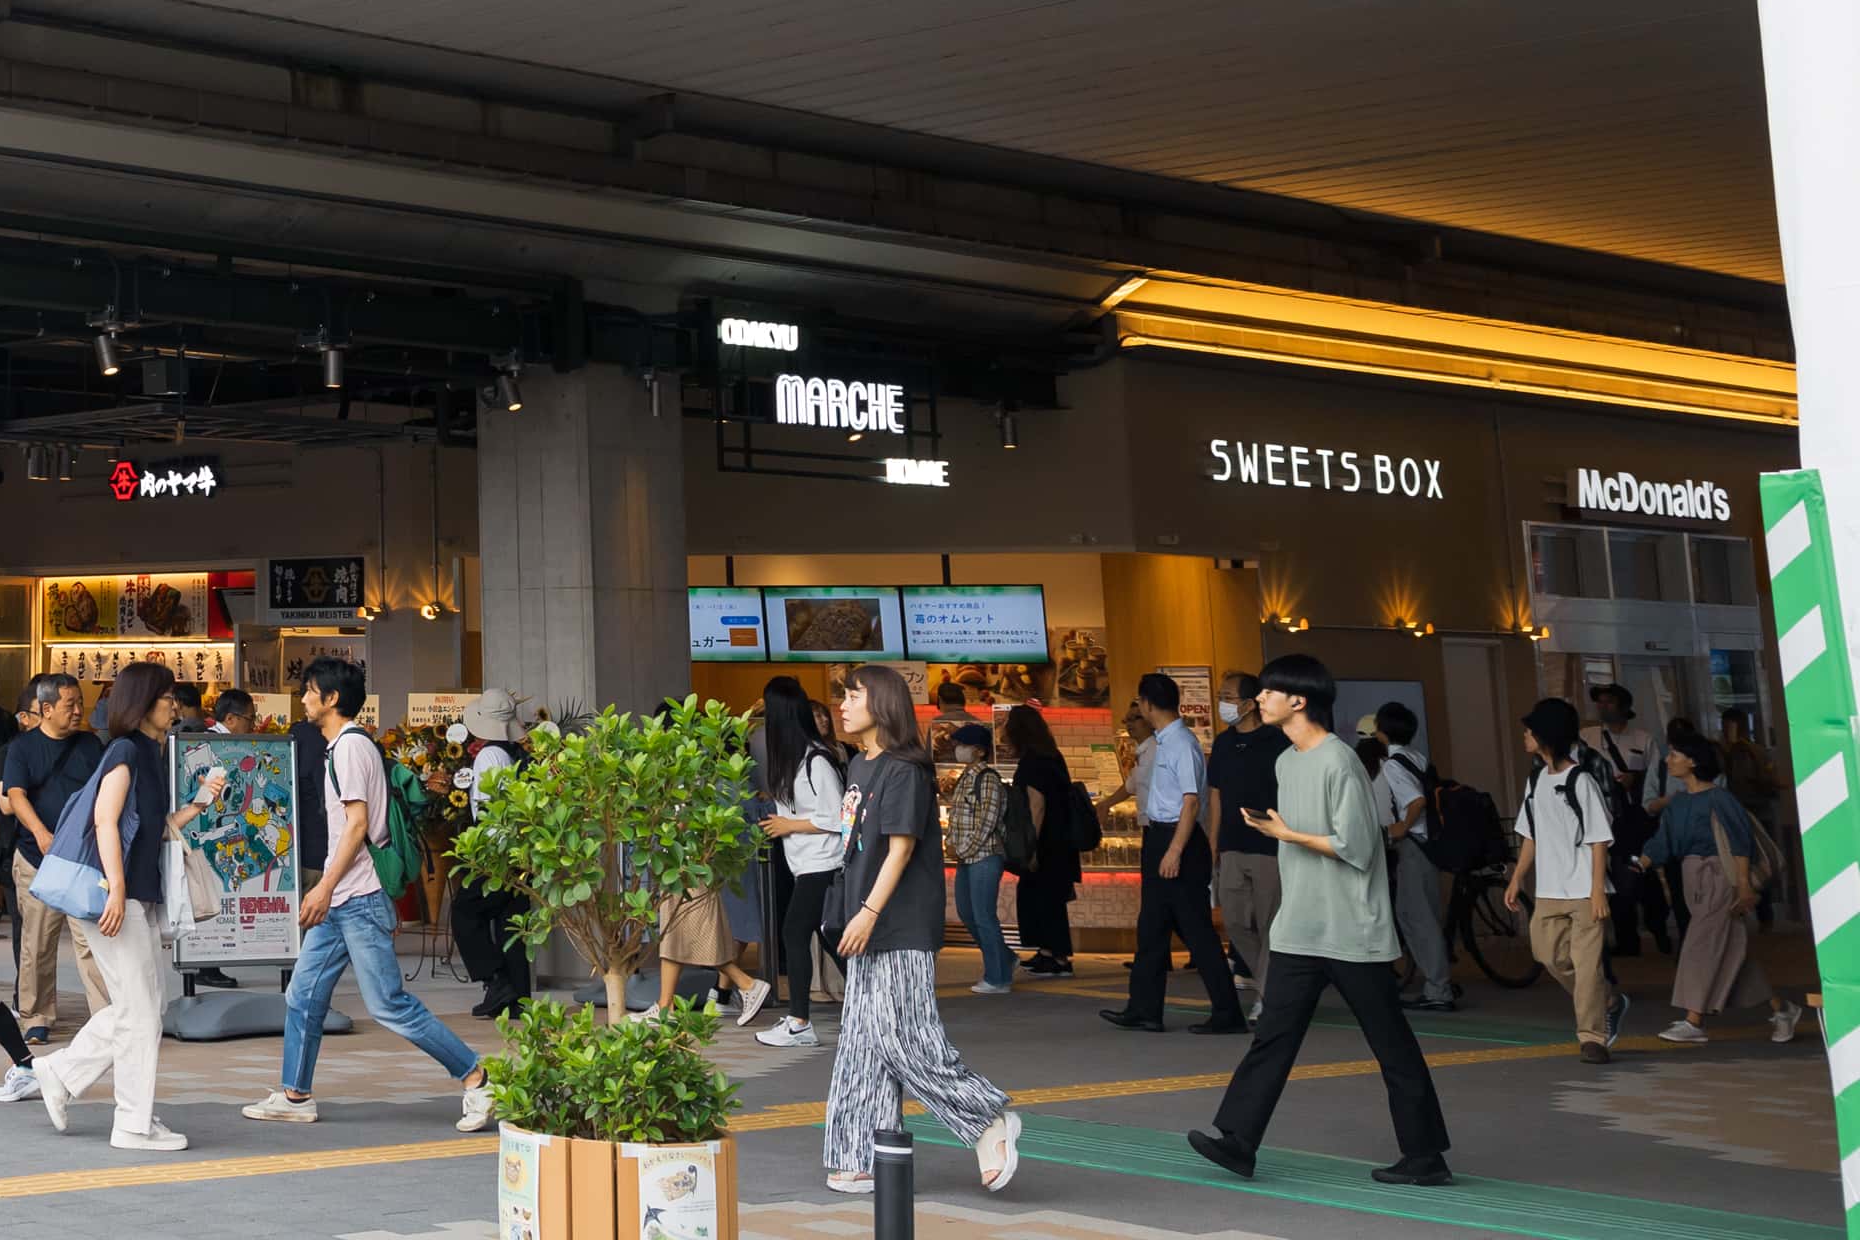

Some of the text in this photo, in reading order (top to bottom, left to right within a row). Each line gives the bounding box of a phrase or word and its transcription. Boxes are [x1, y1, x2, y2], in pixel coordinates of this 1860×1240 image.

[721, 318, 799, 351] ODAKYU
[775, 373, 905, 434] MARCHE
[140, 465, 216, 498] 肉のヤマ牛
[1210, 439, 1444, 499] SWEETS BOX
[1577, 467, 1731, 522] McDonald's
[1180, 704, 1210, 714] OPEN!
[239, 896, 291, 914] RENEWAL
